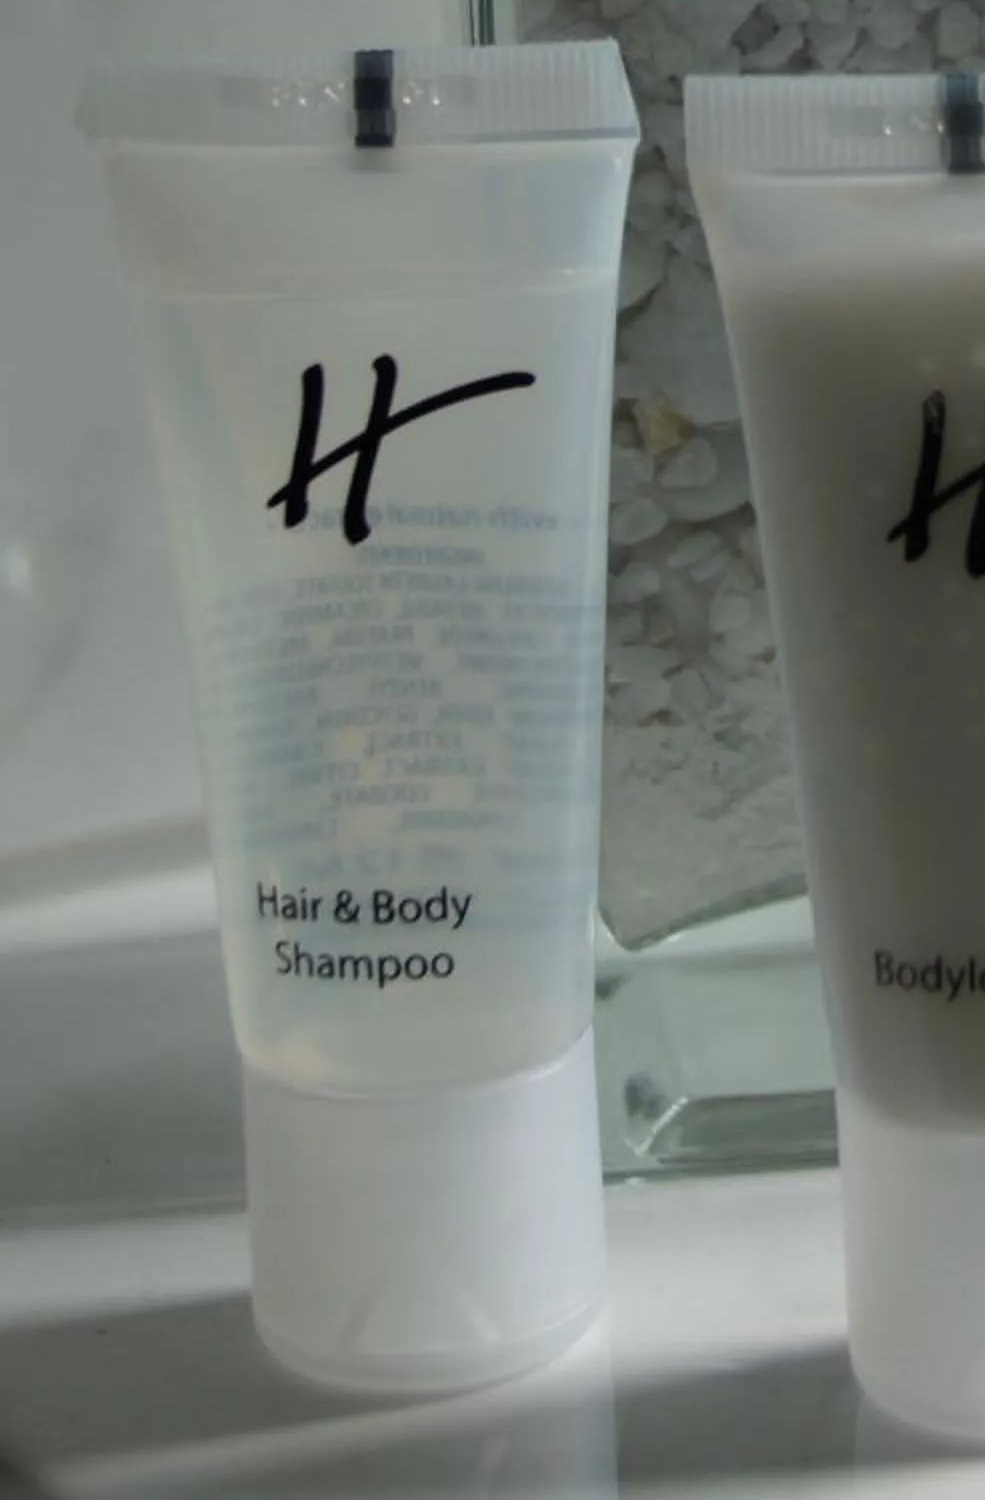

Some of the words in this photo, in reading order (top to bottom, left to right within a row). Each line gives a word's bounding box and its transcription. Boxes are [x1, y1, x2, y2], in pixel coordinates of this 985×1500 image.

[256, 880, 323, 922] Hair
[333, 889, 361, 924] &
[371, 885, 473, 930] Body
[274, 940, 455, 989] Shampoo
